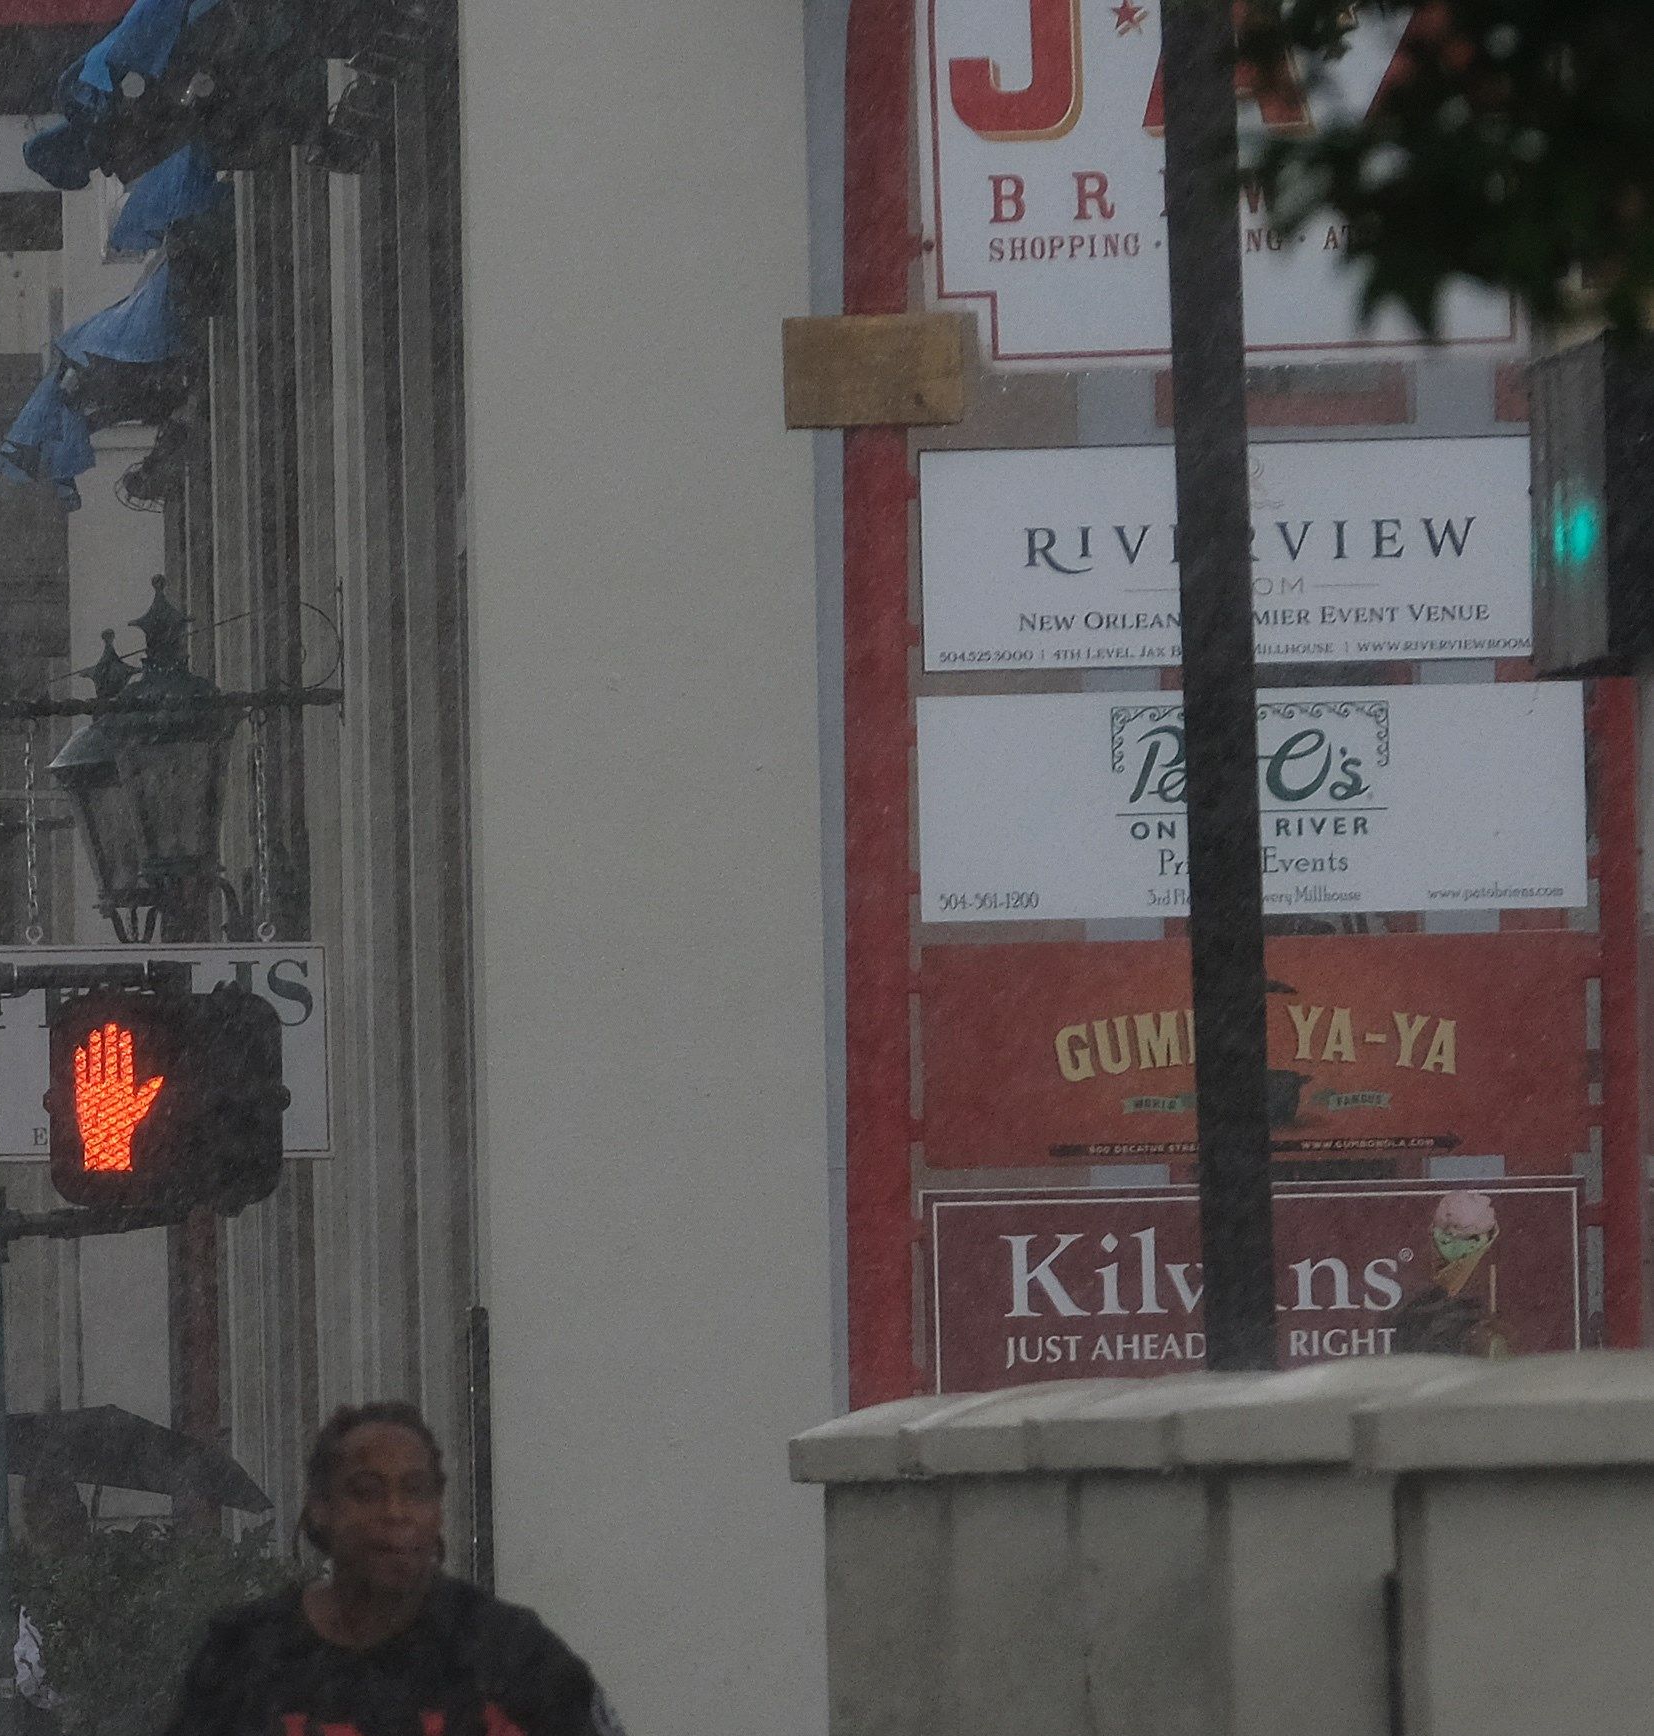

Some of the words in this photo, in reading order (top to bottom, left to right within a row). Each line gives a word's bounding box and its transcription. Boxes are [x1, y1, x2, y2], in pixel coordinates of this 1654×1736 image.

[988, 231, 1142, 261] SHOPPING
[1024, 515, 1478, 575] RIVVIEW
[1255, 575, 1305, 596] OM
[1019, 610, 1078, 633] NEW
[1084, 609, 1182, 632] ORLEAN
[1253, 605, 1311, 627] MIER
[1319, 602, 1399, 625] EVENT
[1407, 600, 1490, 623] VENUE
[1265, 727, 1372, 803] O's
[1130, 819, 1177, 841] ON
[1275, 815, 1370, 838] RIVER
[1262, 849, 1349, 876] Events
[1293, 883, 1363, 904] Millhouse
[1054, 1008, 1195, 1083] GUM
[1288, 1004, 1458, 1077] YA-YA
[998, 1226, 1405, 1320] Kilns
[1006, 1335, 1084, 1370] JUST
[1091, 1332, 1207, 1362] AHEAD
[1289, 1327, 1398, 1358] RIGHT
